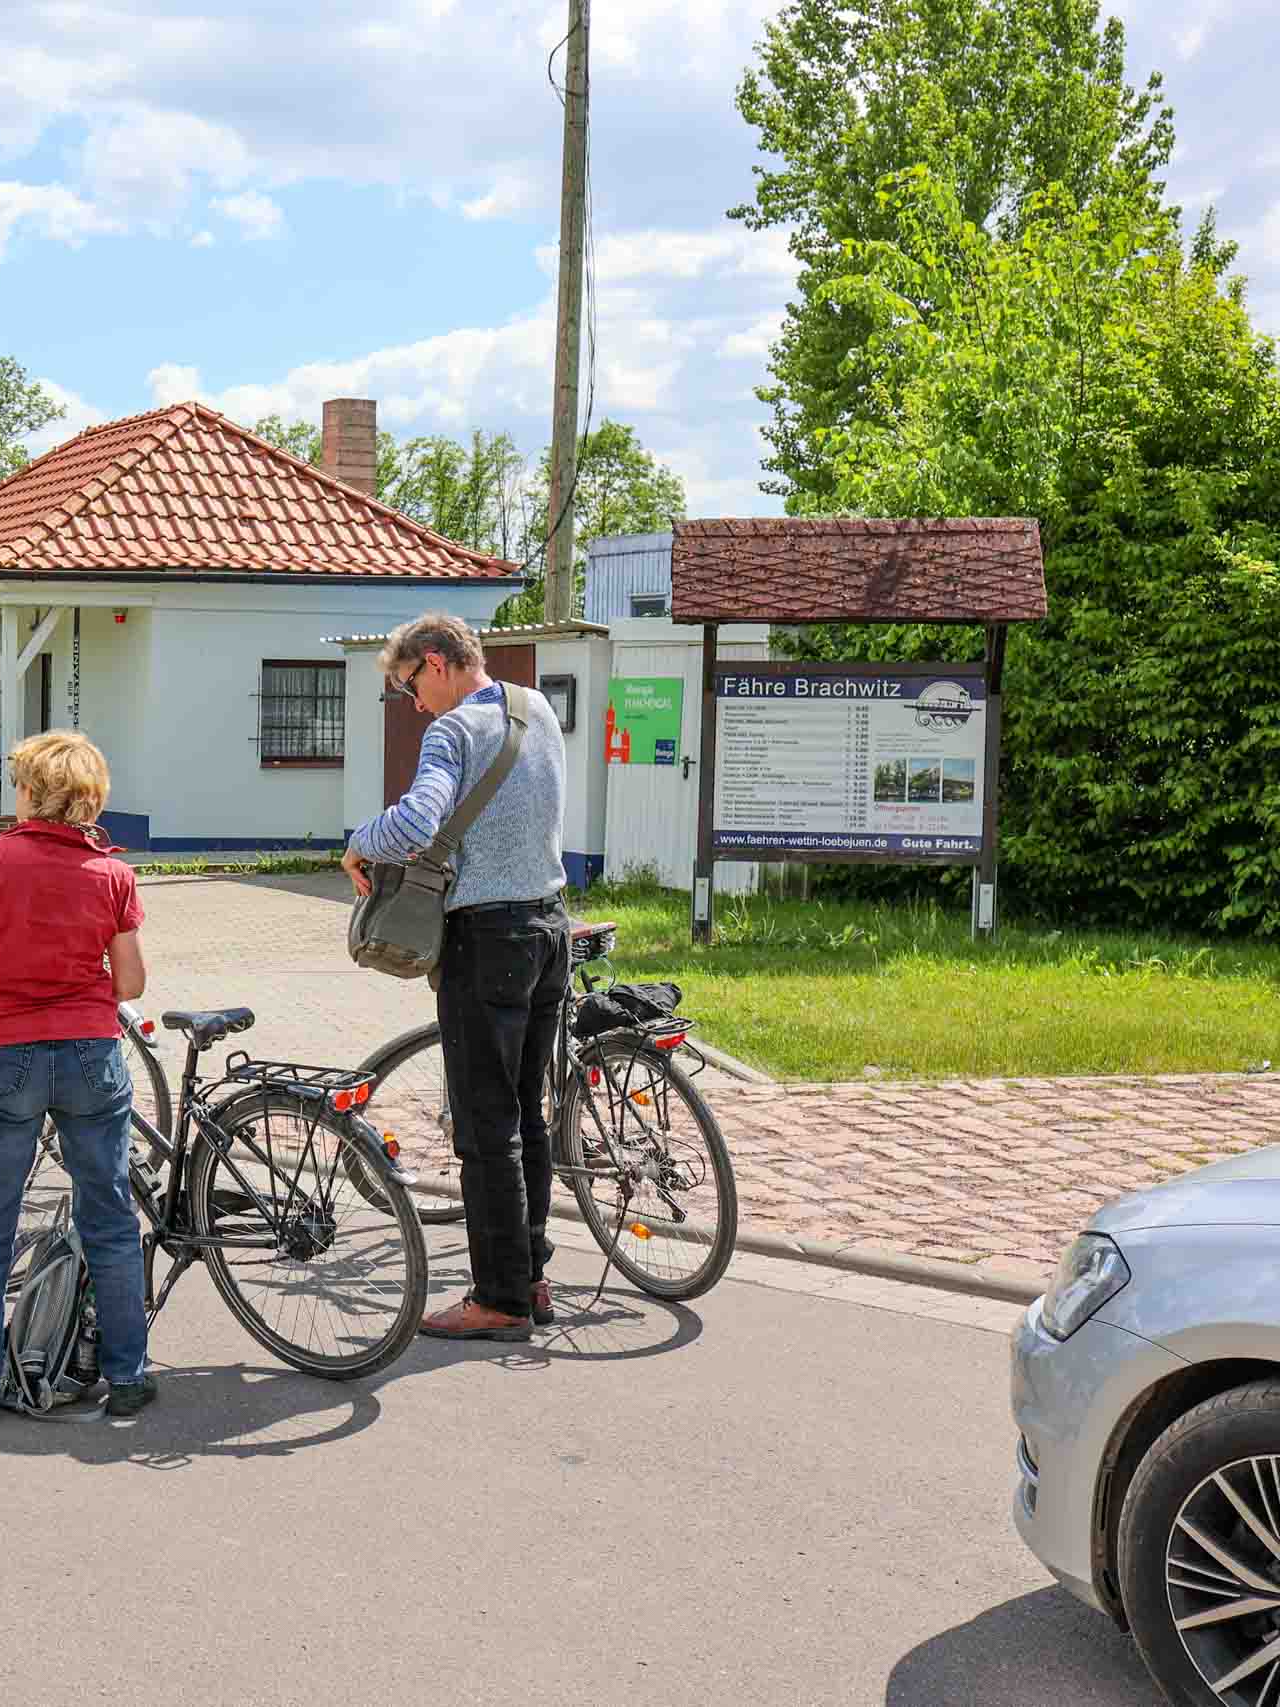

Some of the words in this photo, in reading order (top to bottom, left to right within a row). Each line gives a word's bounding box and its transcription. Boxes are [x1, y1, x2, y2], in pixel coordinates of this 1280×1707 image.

[723, 677, 786, 696] Fähre
[795, 678, 901, 697] Brachwitz
[902, 837, 934, 848] Gute
[936, 838, 974, 849] Fahrt.
